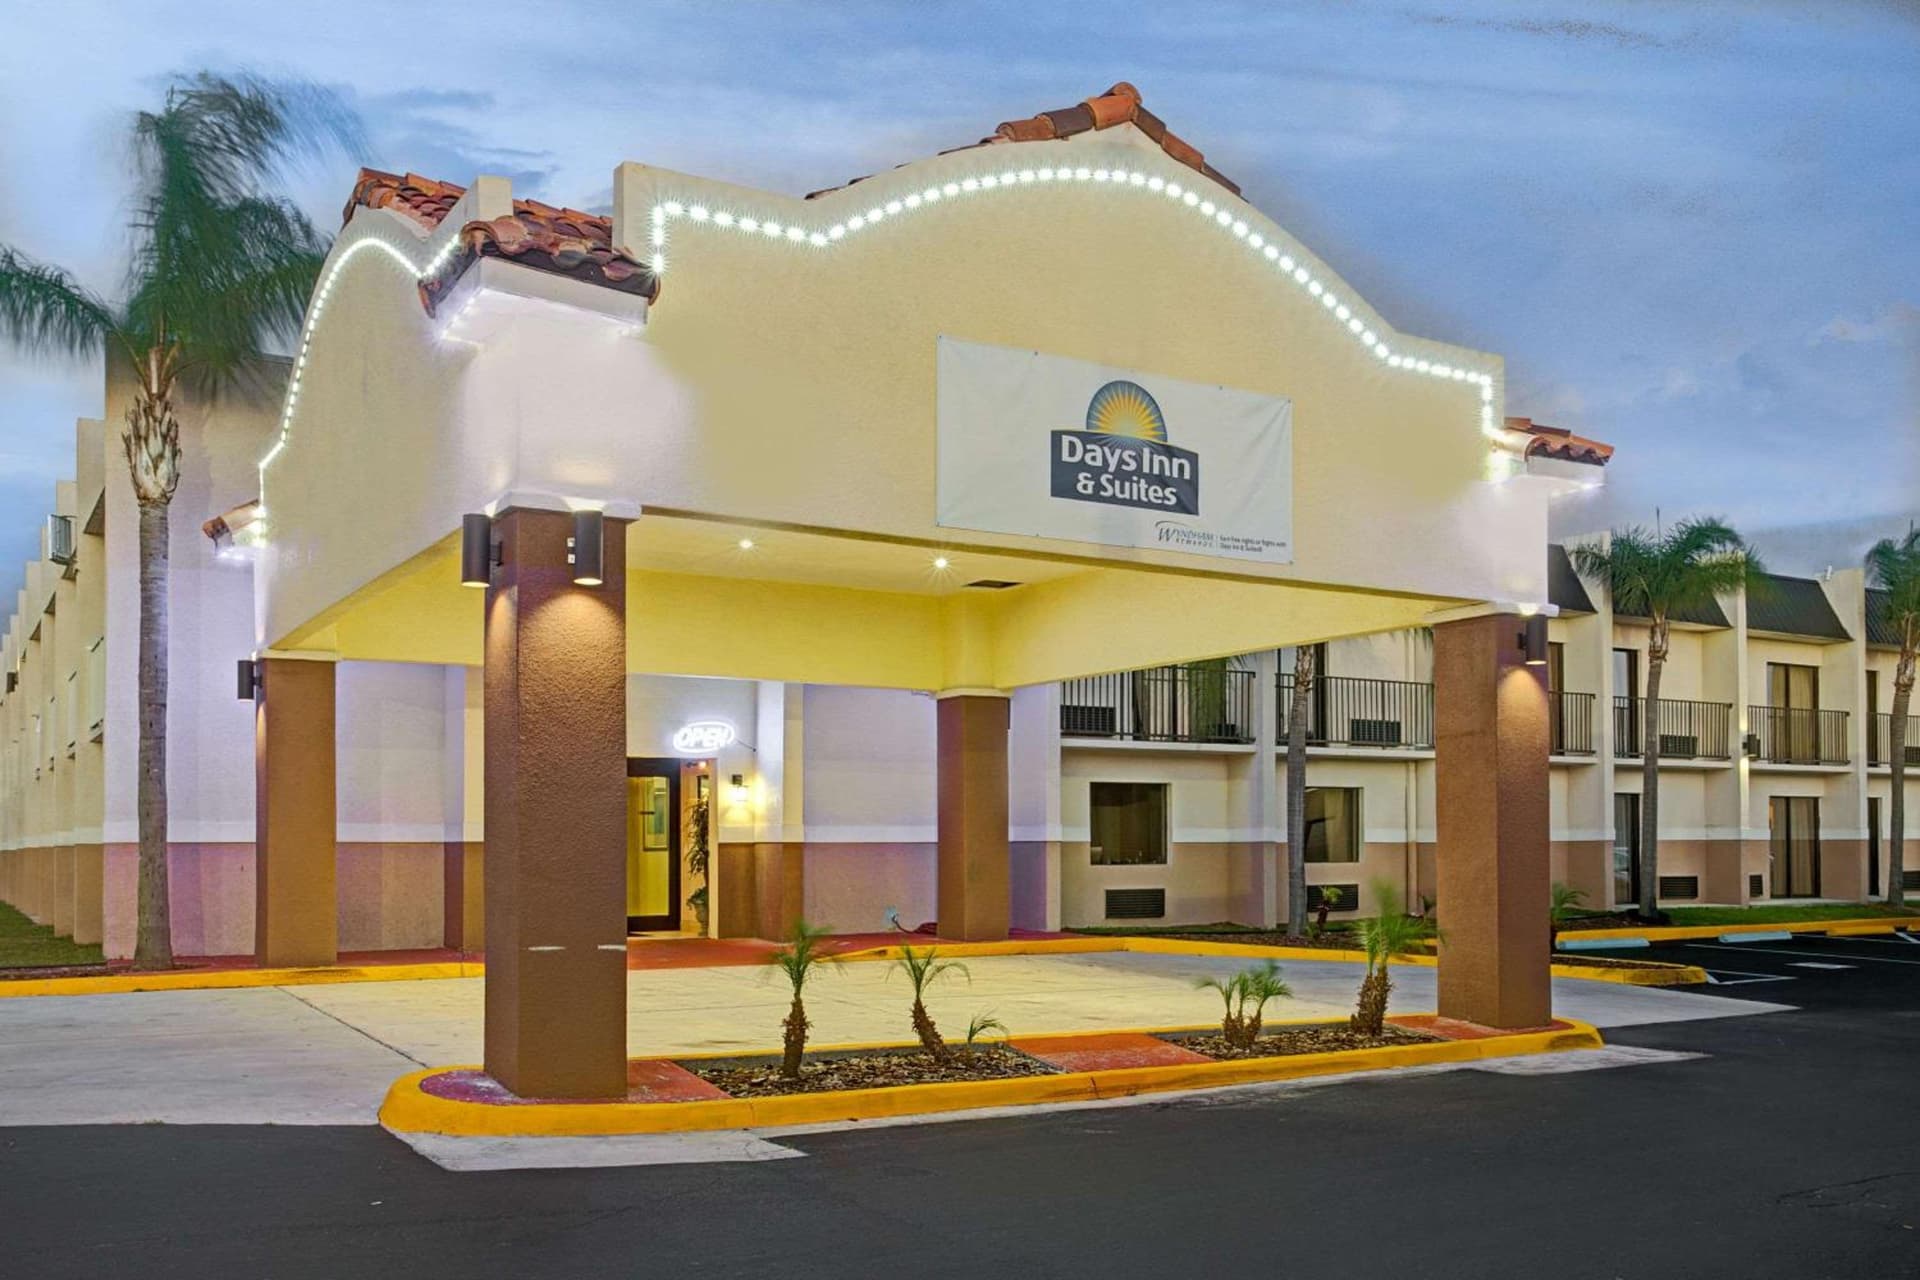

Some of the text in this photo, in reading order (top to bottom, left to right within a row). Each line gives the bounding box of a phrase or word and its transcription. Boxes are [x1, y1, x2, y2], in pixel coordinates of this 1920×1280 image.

[1061, 434, 1191, 480] Days Inn
[1076, 472, 1177, 505] & Suites
[679, 727, 728, 747] OPEN
